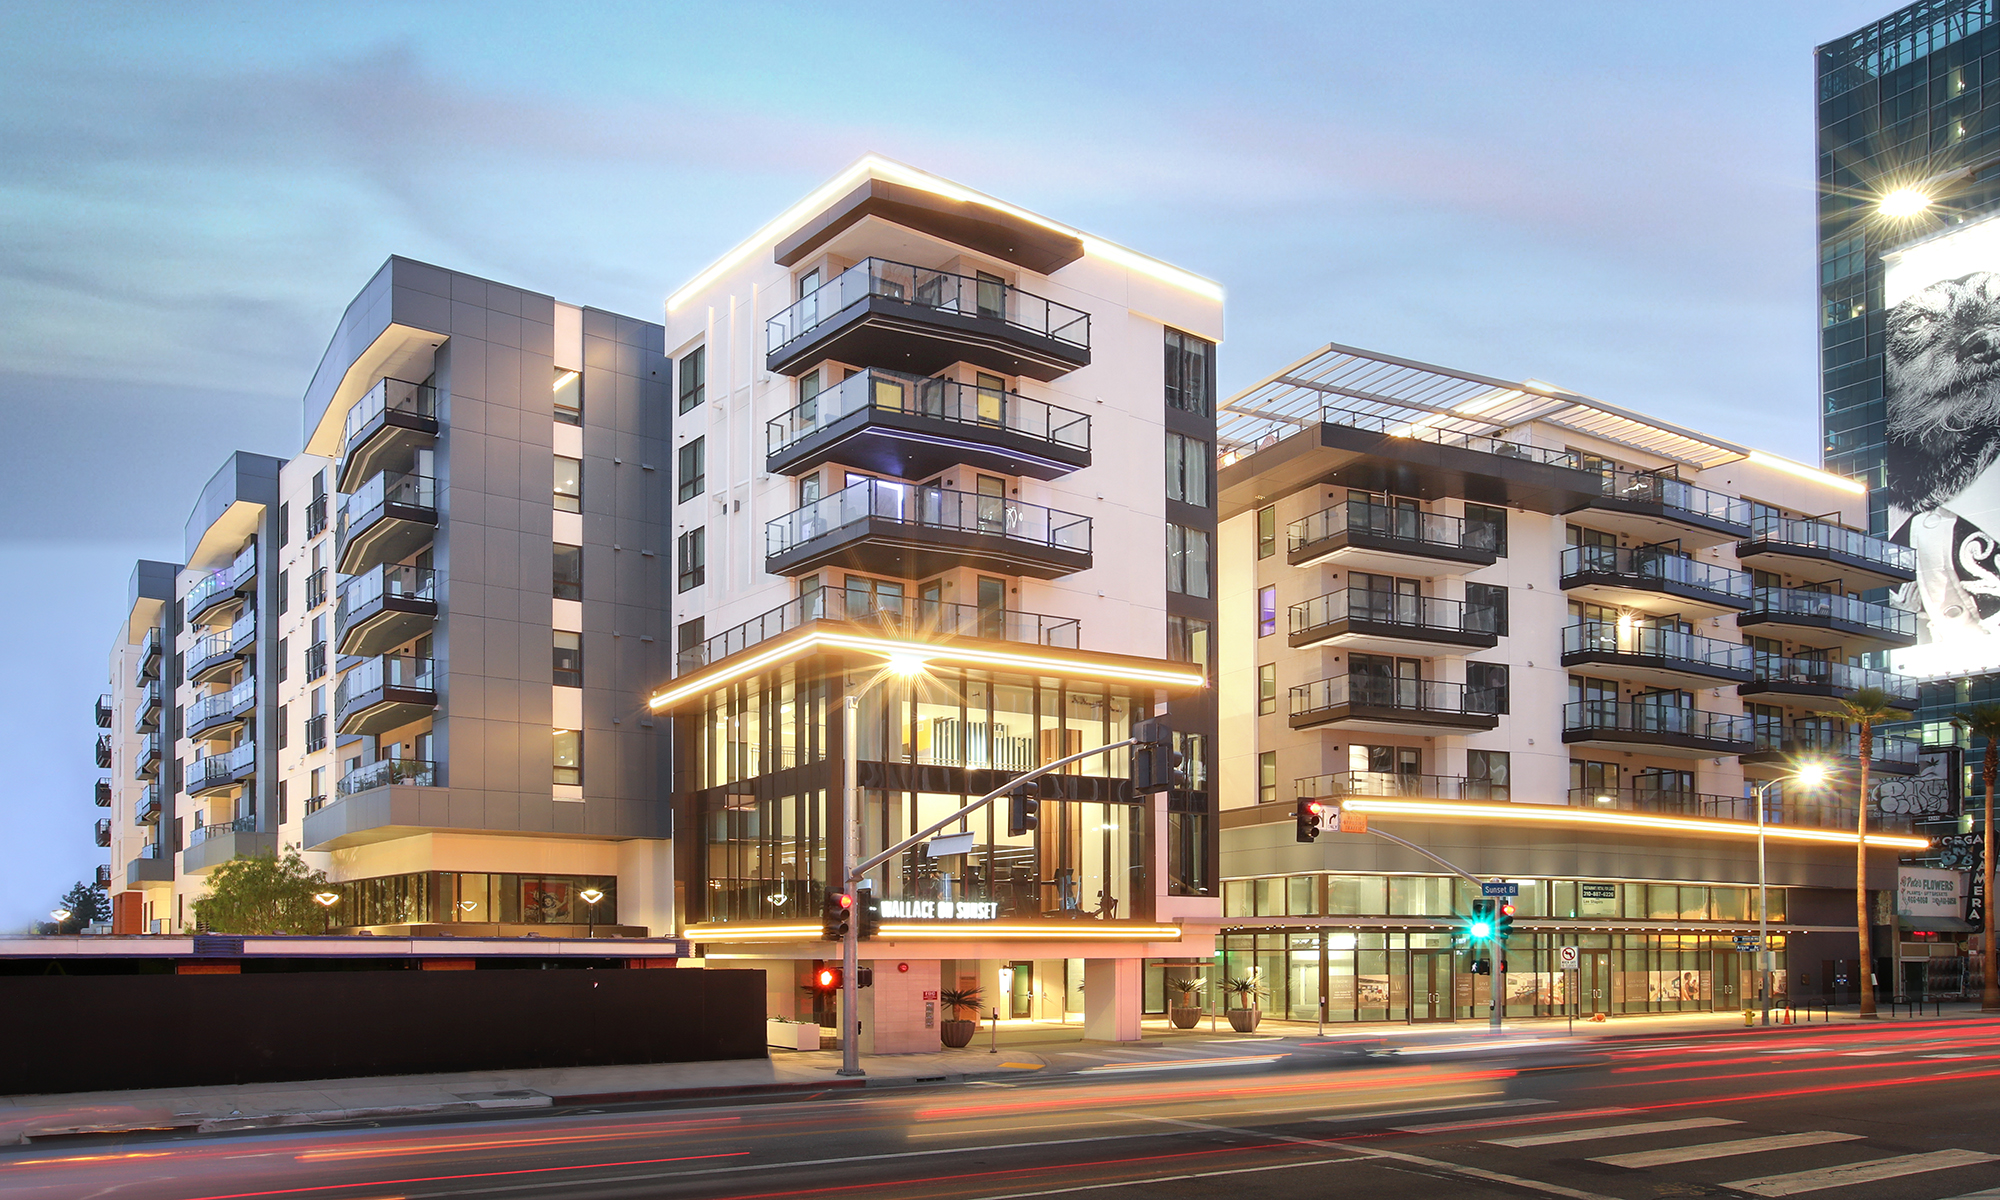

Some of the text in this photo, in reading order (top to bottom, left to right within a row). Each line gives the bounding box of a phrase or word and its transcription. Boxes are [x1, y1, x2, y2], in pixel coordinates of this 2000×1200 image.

[1931, 834, 1984, 846] MORGA
[1485, 886, 1516, 894] Sunset Bl
[1923, 880, 1954, 891] FLOWERS
[880, 900, 935, 919] WALLACE
[956, 901, 998, 919] SUNSET
